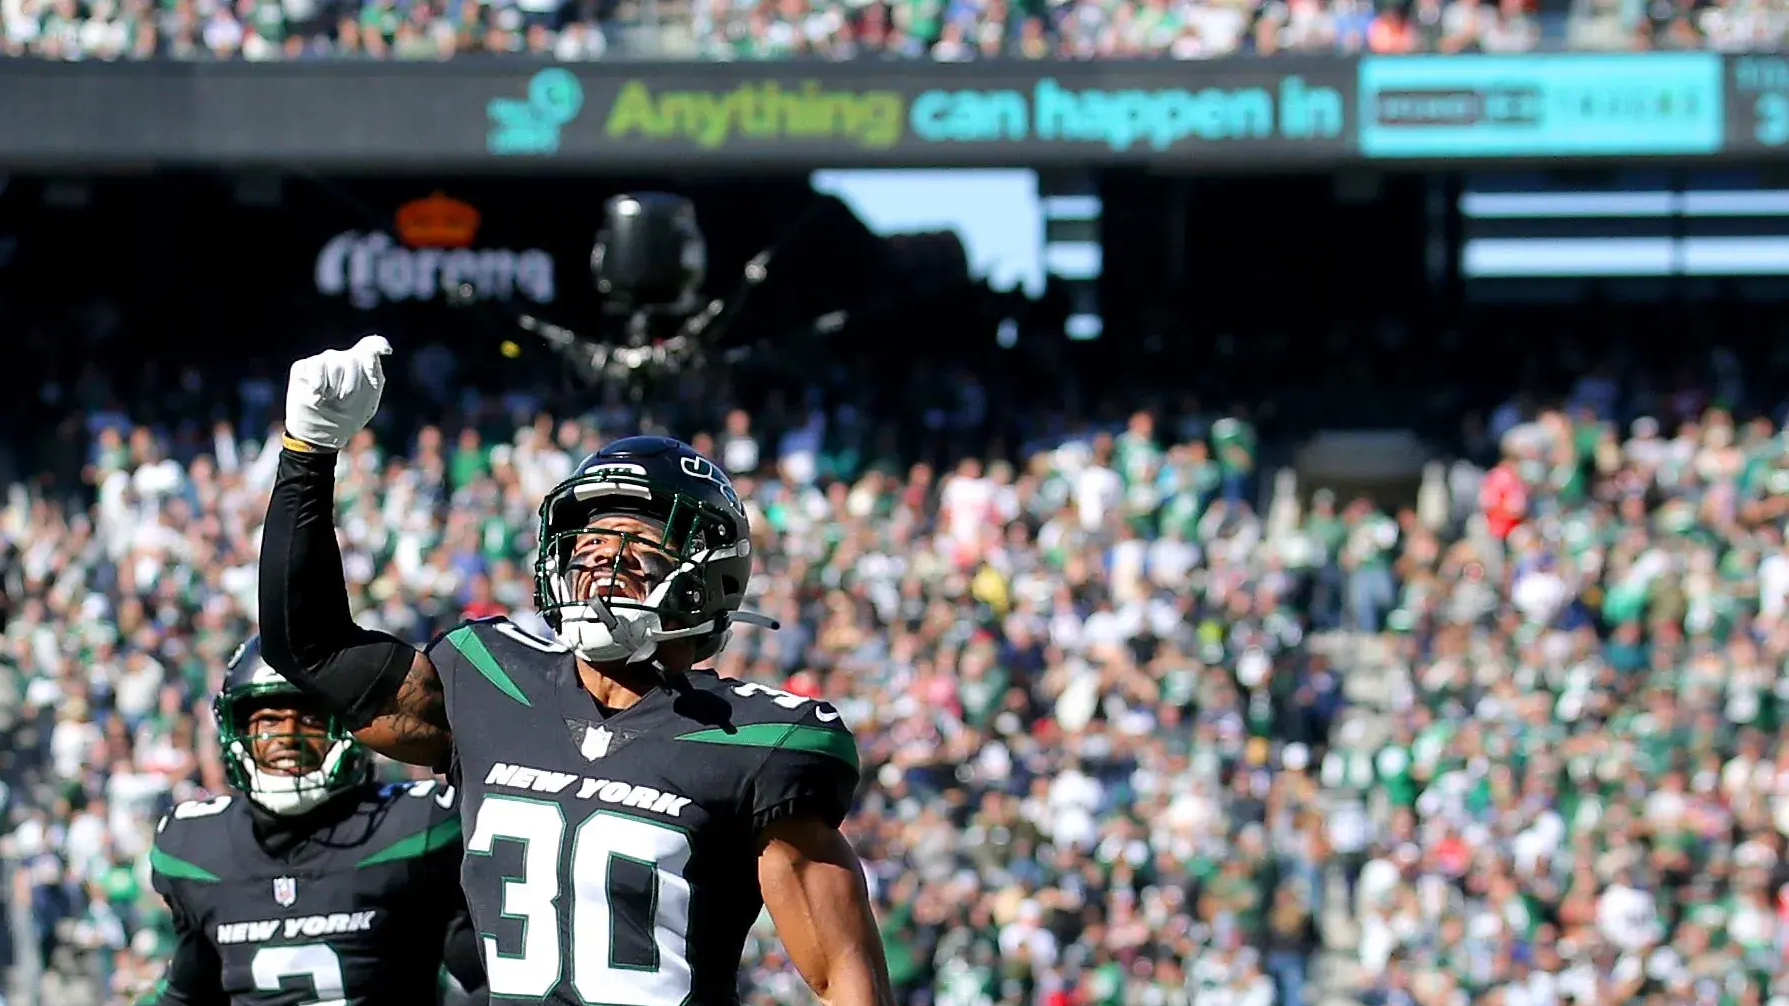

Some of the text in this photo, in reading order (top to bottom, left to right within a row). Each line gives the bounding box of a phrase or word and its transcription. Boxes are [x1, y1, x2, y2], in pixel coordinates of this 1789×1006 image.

[605, 80, 903, 149] Anything
[911, 89, 1029, 142] can
[1033, 76, 1274, 152] happen
[1278, 74, 1345, 140] in
[484, 762, 692, 817] NEW YORK
[216, 910, 377, 944] NEW YORK
